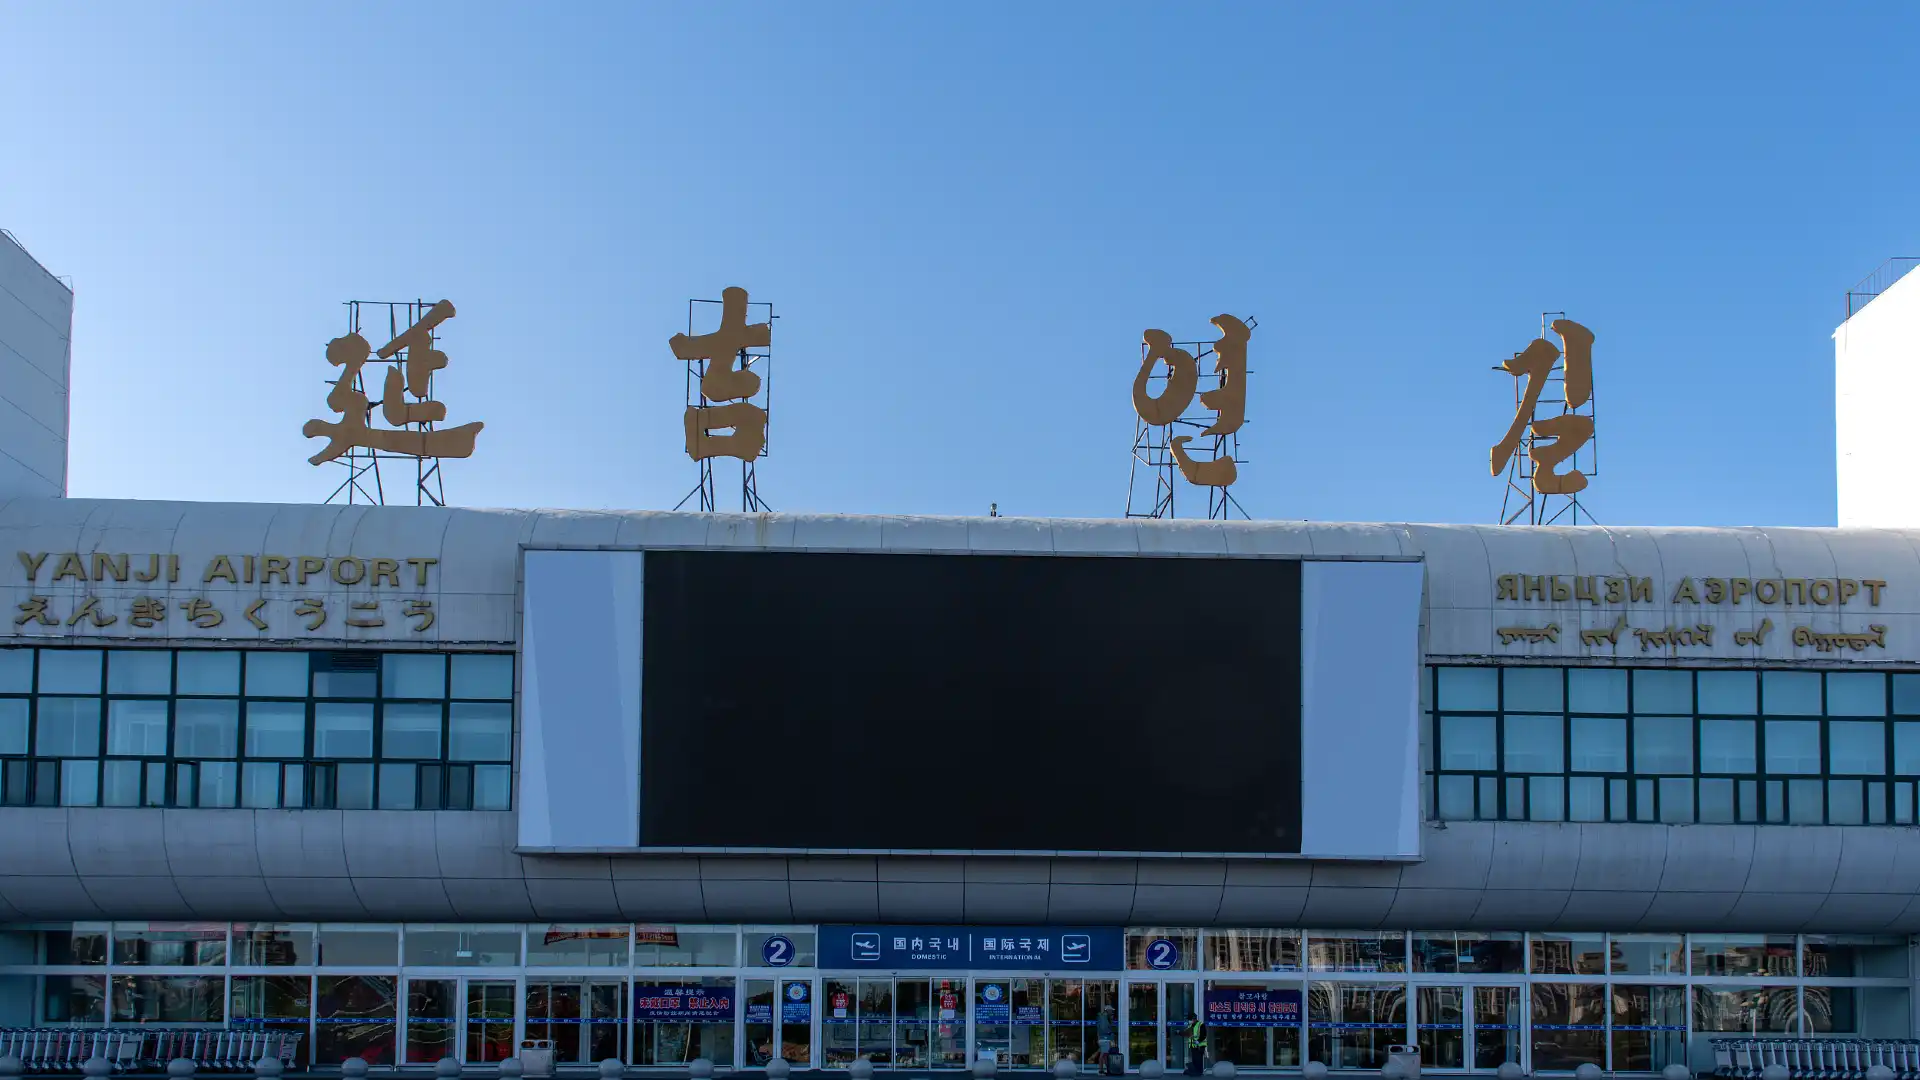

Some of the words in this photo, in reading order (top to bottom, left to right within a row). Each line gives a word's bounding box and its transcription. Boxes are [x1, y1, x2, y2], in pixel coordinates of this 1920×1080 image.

[17, 551, 179, 582] YANJI
[202, 554, 438, 586] AIRPORT
[1496, 573, 1654, 605] ЯНЬЦЗИ
[1673, 576, 1888, 607] АЭРОПОРТ
[768, 940, 788, 963] 2
[1152, 943, 1171, 966] 2
[688, 996, 730, 1009] 禁止入内
